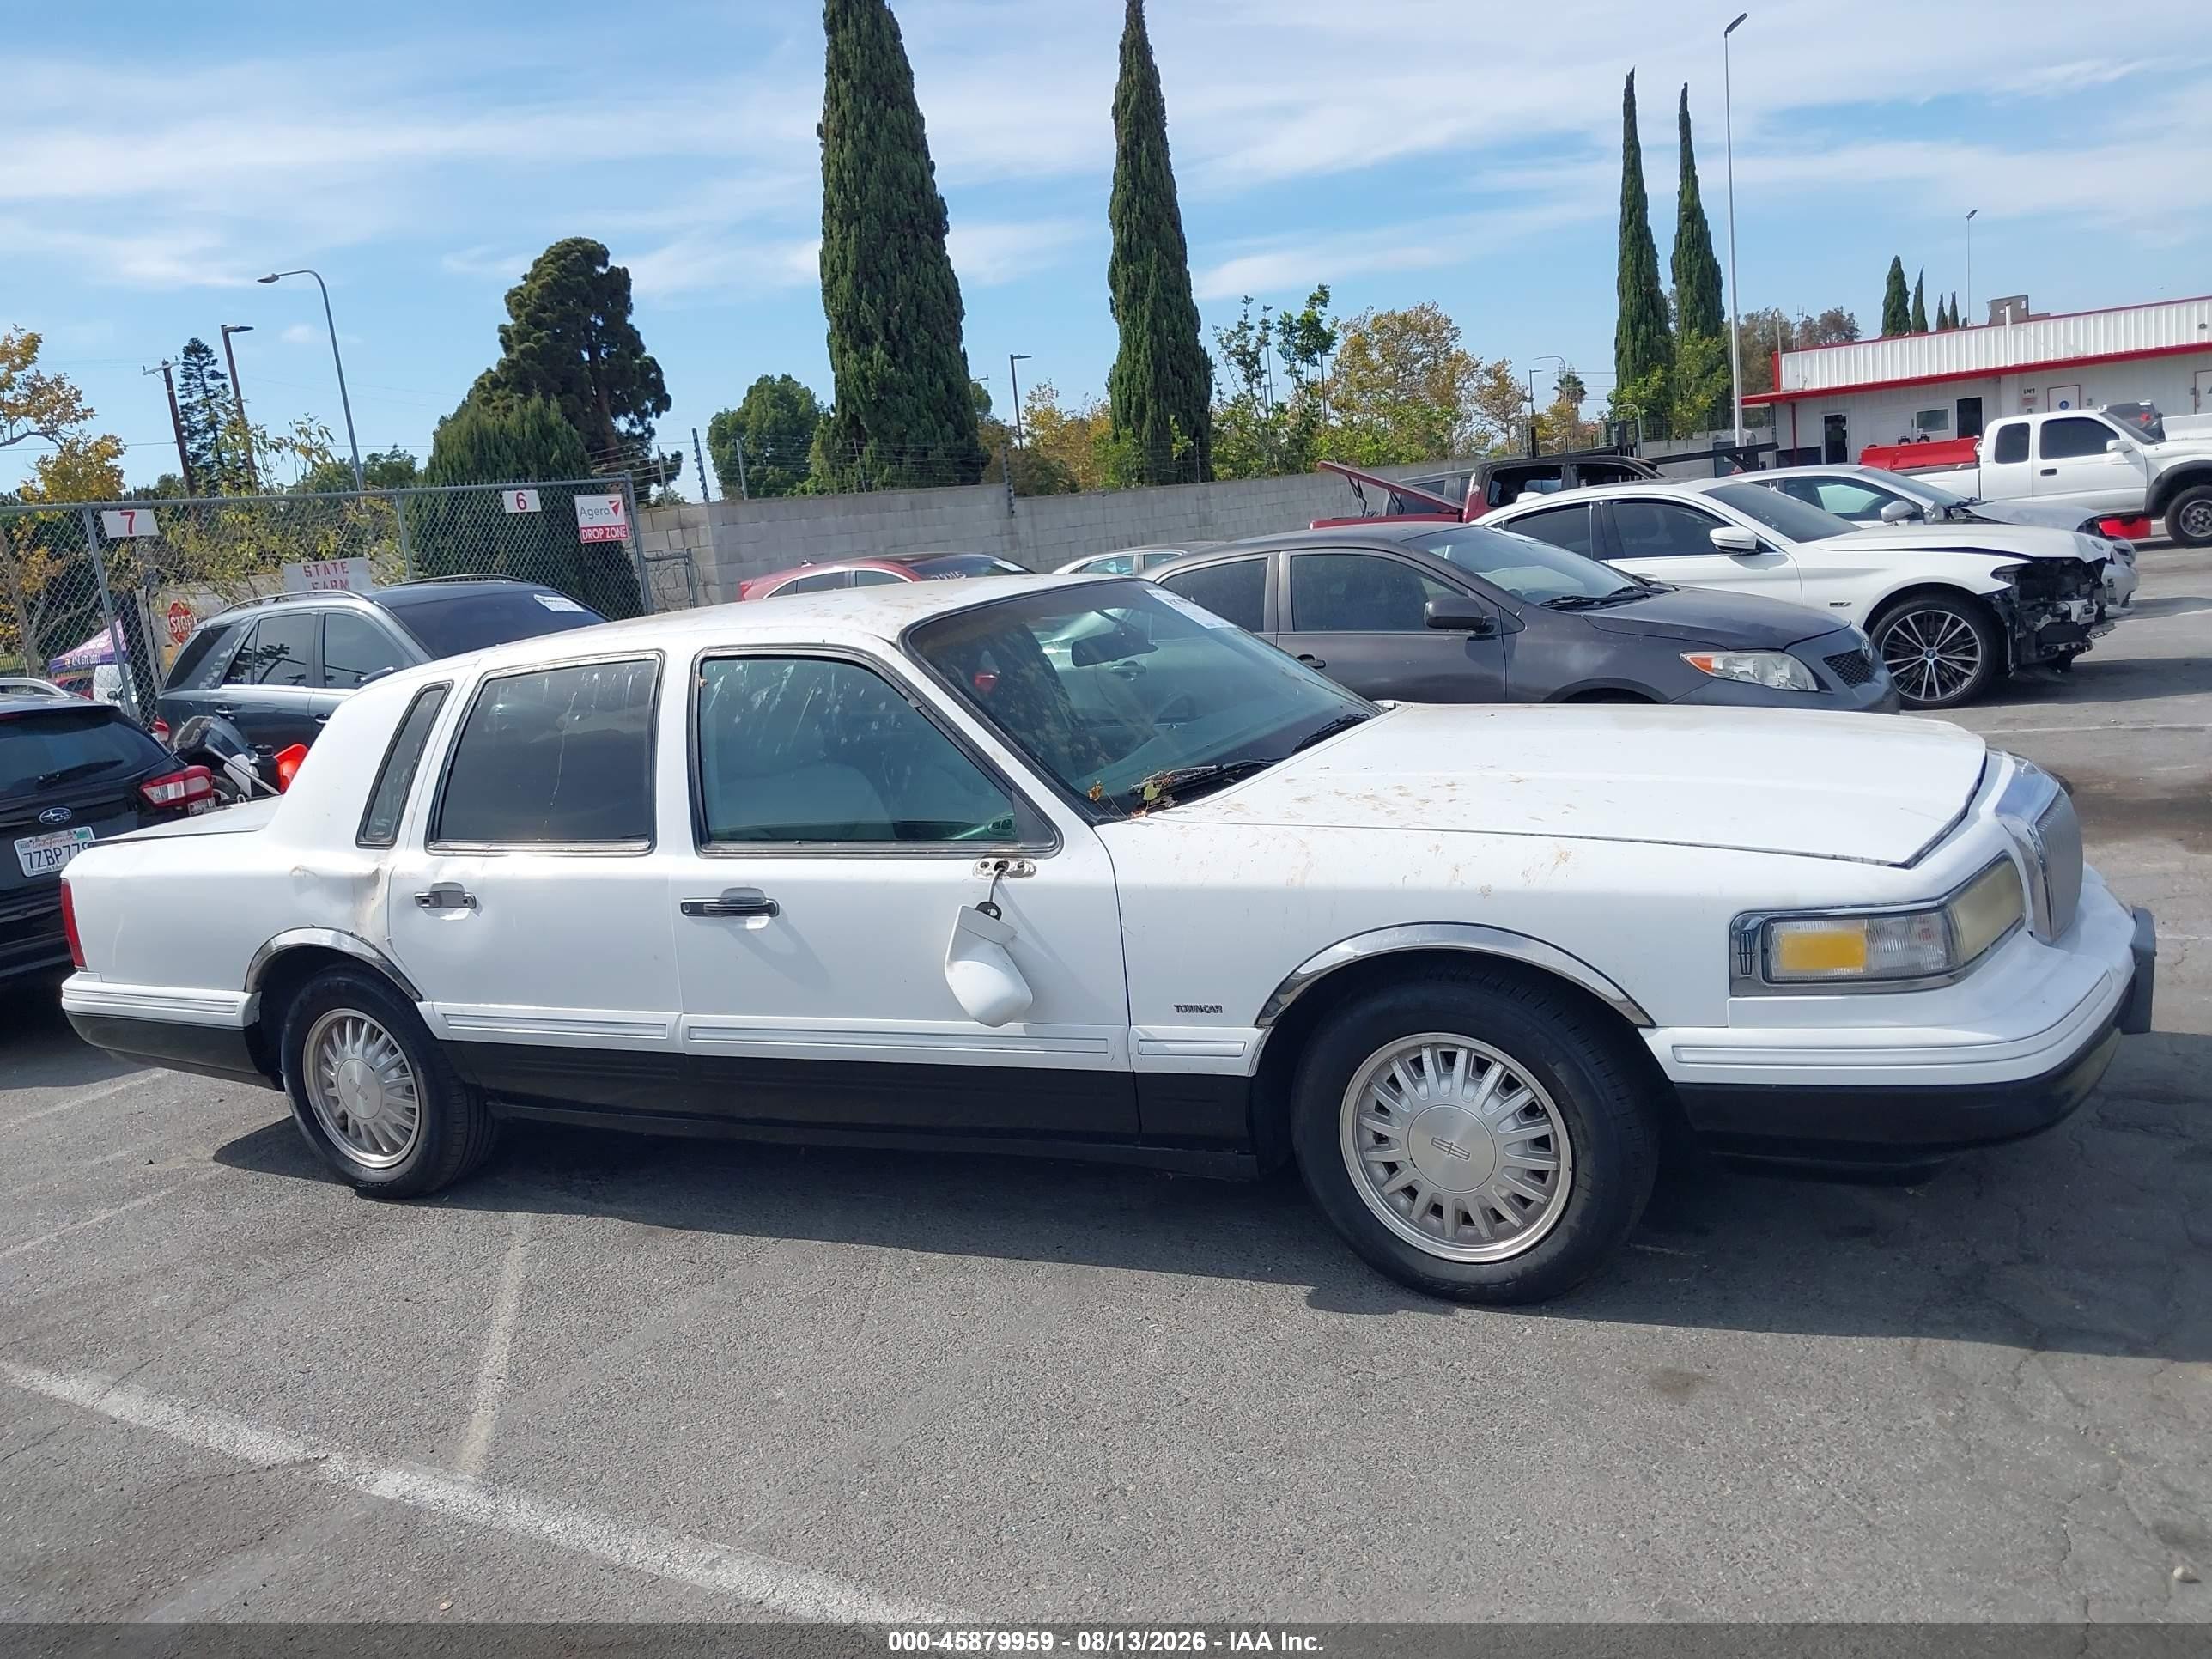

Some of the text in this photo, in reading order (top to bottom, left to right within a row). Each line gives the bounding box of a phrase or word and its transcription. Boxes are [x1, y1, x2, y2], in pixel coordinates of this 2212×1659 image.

[515, 491, 527, 511] 6
[580, 507, 610, 520] Agero
[120, 511, 136, 535] 7
[581, 526, 627, 541] DROP ZONE
[303, 562, 349, 578] STATE
[170, 614, 192, 634] STOP
